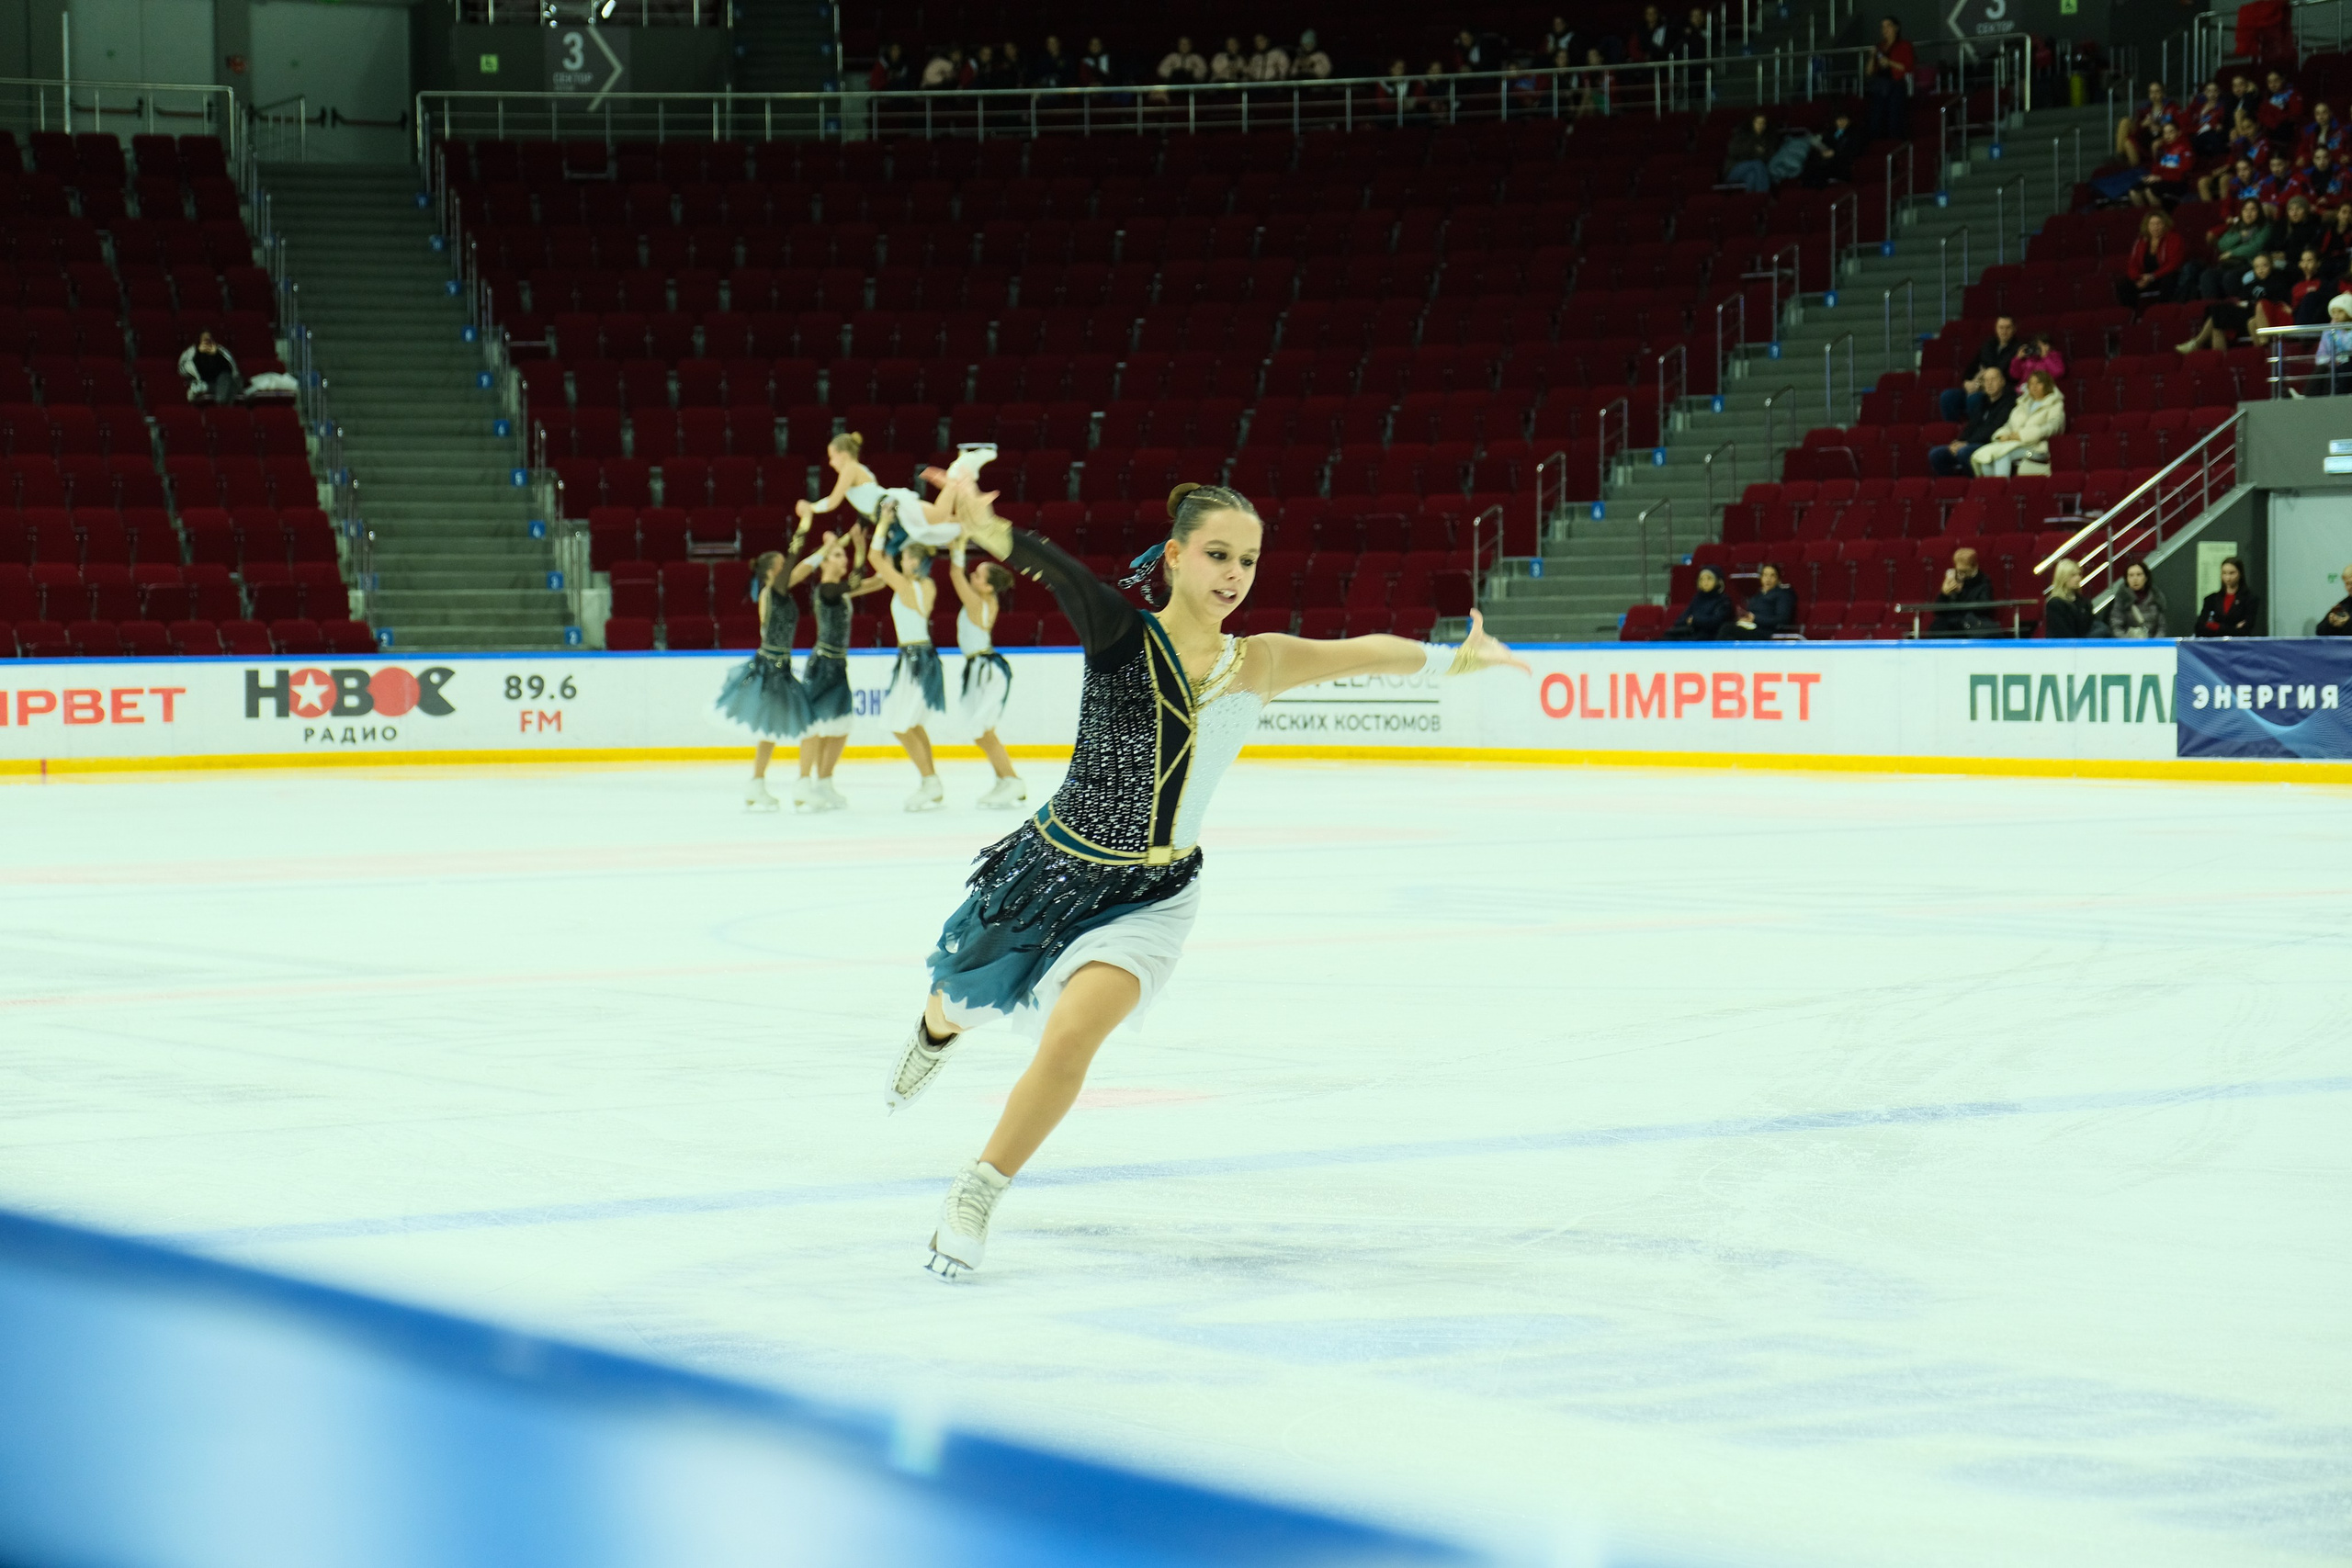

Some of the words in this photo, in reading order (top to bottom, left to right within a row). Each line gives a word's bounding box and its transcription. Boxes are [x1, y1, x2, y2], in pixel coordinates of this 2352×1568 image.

[562, 31, 584, 71] 3
[504, 674, 577, 700] 89.6
[1540, 672, 1822, 720] OLIMPBET
[1970, 673, 2177, 723] ПОЛИПЛ
[2192, 684, 2340, 709] ЭНЕРГИЯ
[0, 687, 187, 727] PBET
[520, 710, 562, 732] FM
[1335, 715, 1442, 731] КОСТЮМОВ
[304, 726, 397, 743] РАДИО
